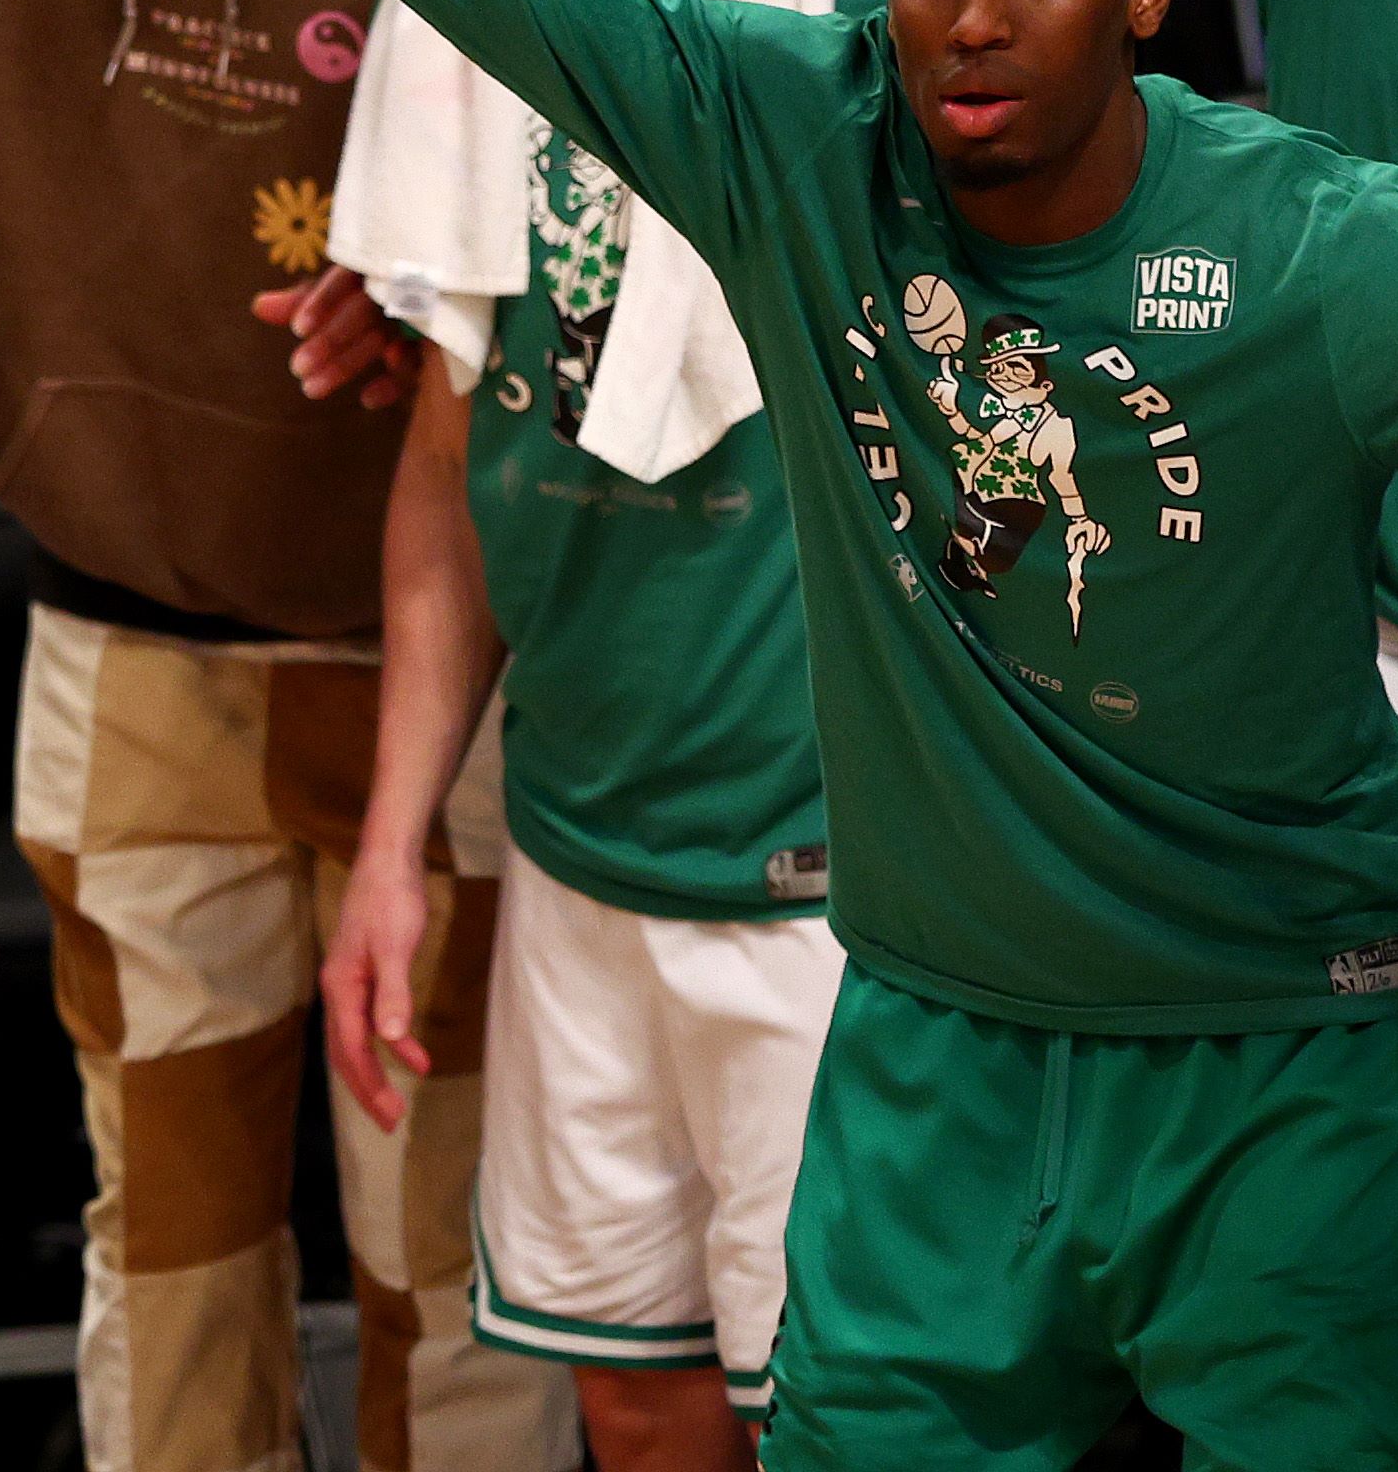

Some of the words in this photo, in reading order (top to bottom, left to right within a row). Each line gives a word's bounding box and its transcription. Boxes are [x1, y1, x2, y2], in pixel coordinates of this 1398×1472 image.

[1140, 256, 1230, 298] VISTA
[1136, 297, 1227, 330] PRINT
[1084, 344, 1203, 544] PRIDE
